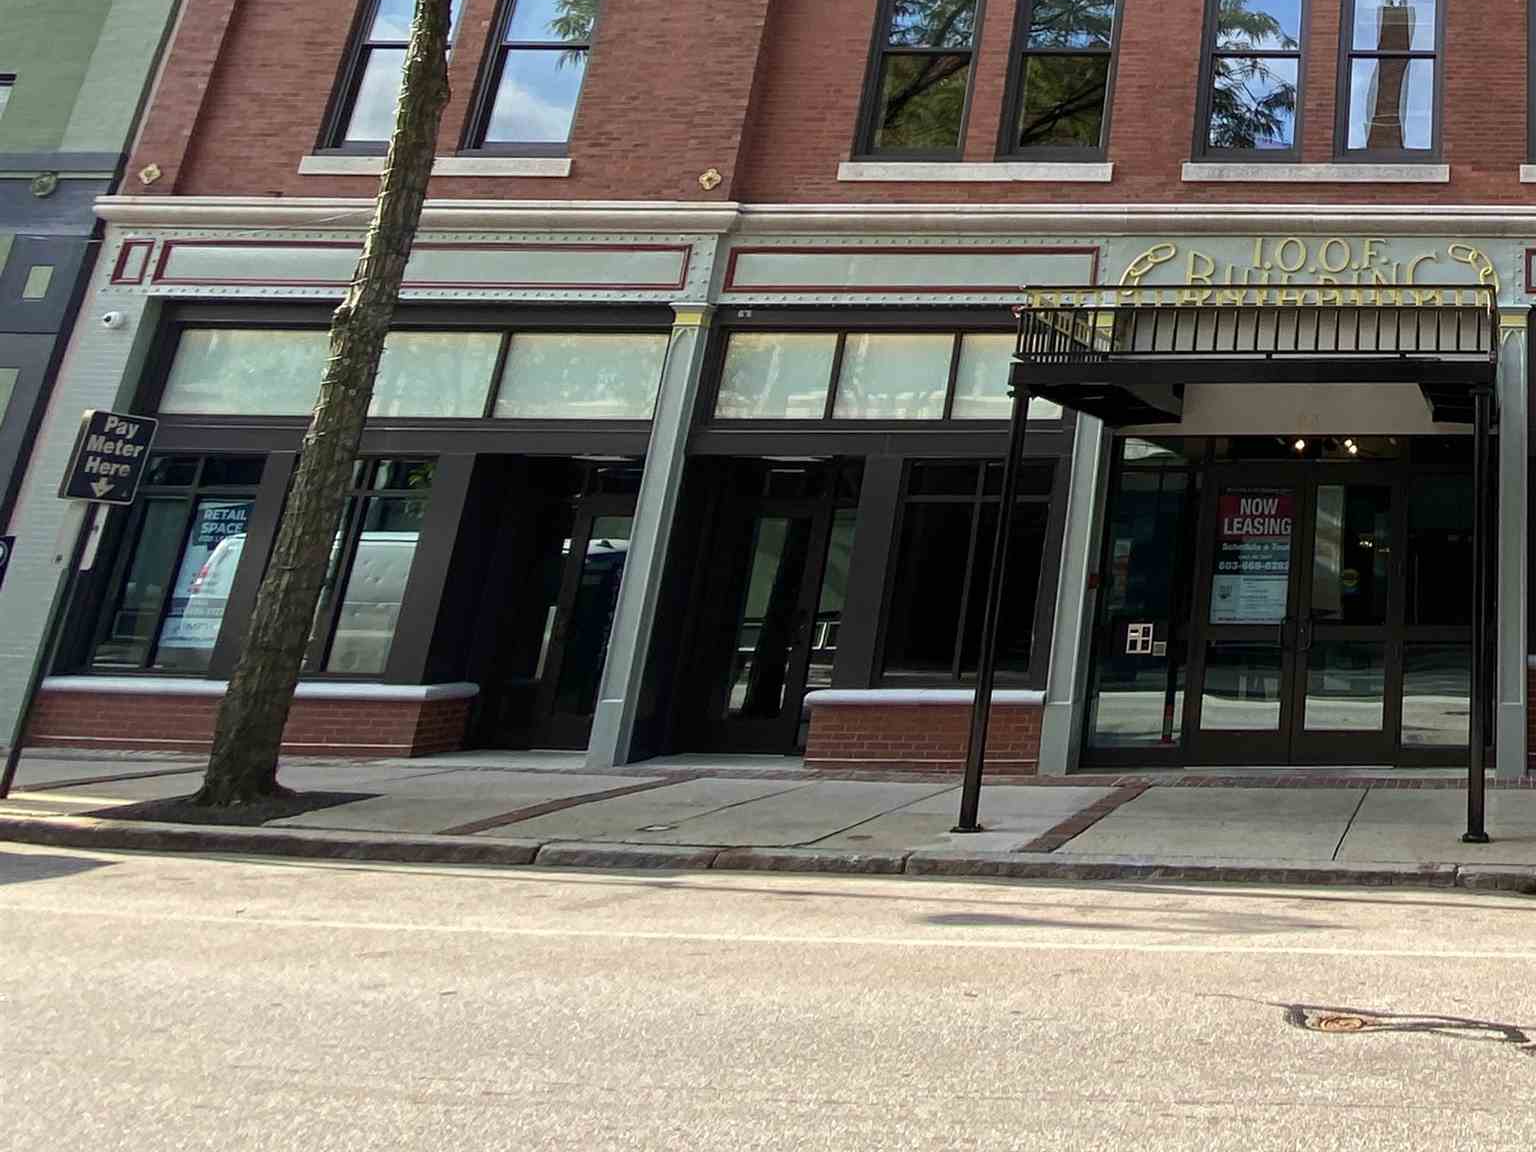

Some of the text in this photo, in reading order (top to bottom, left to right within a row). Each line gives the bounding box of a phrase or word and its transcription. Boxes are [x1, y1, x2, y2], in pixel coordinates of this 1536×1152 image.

[1252, 237, 1389, 273] I.O.O.F.
[103, 415, 139, 439] Pay
[86, 434, 144, 457] Meter
[84, 455, 131, 476] Here
[203, 508, 247, 521] RETAIL
[1240, 498, 1279, 514] NOW
[200, 522, 243, 534] SPACE
[1223, 518, 1292, 535] LEASING
